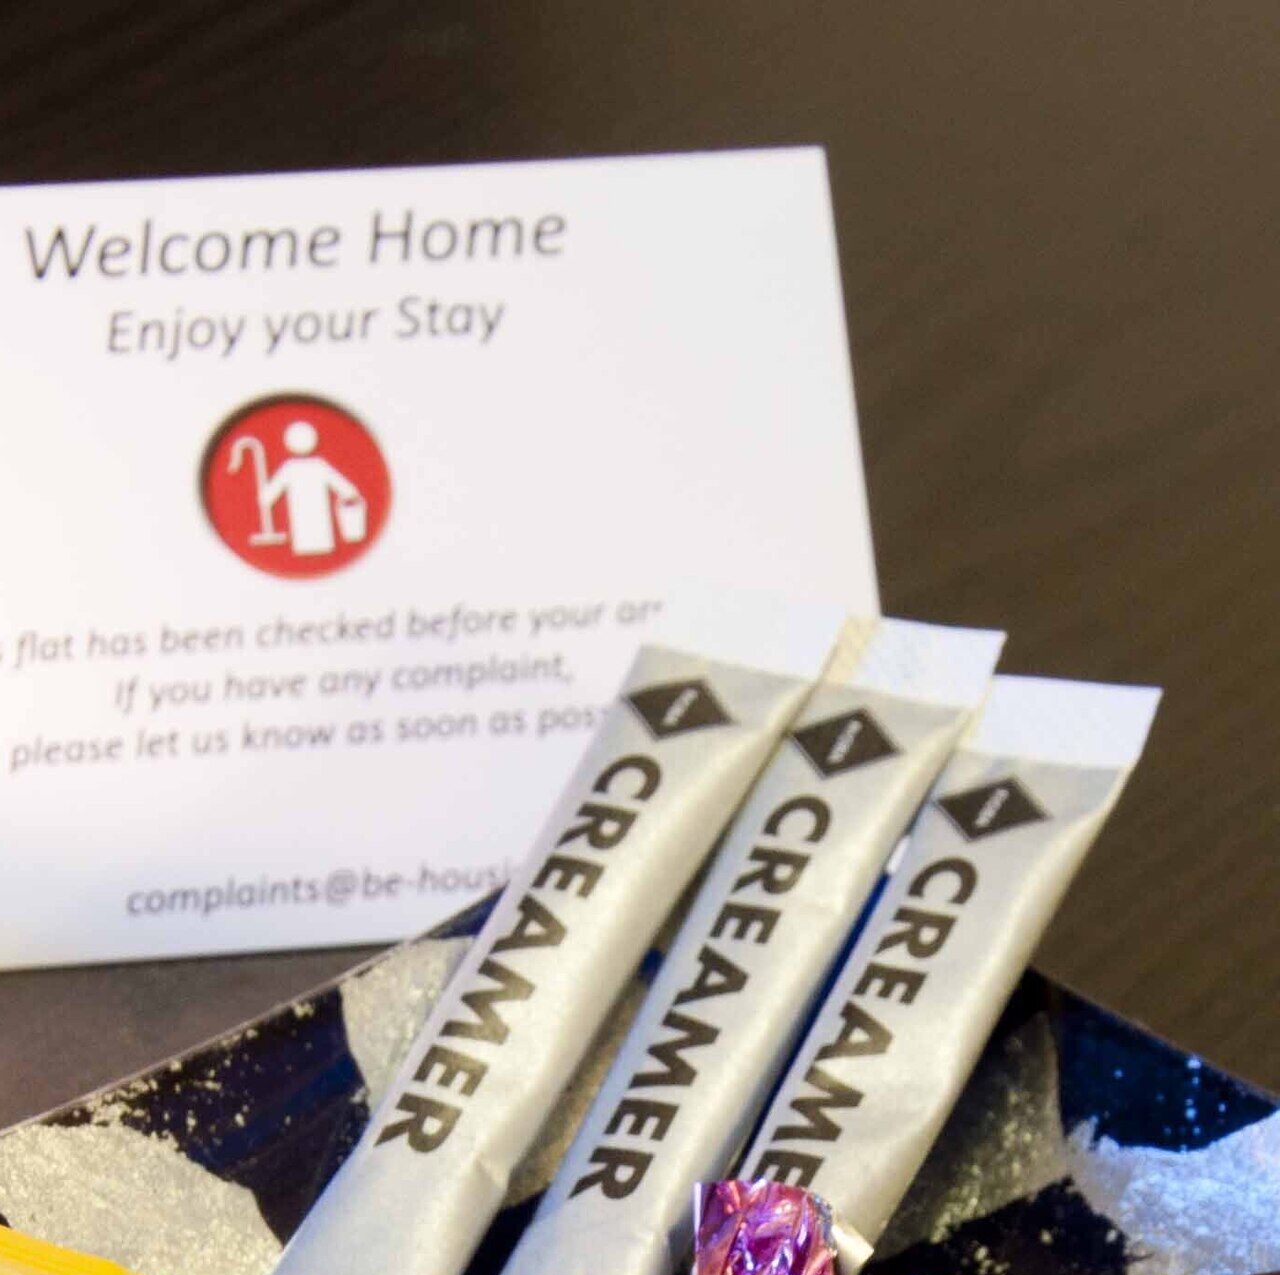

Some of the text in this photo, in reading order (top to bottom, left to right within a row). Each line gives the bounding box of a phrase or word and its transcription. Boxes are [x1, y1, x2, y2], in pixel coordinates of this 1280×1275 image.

[24, 207, 569, 280] Welcome Home
[106, 294, 507, 362] Enjoy your Stay
[13, 628, 76, 669] flat
[86, 628, 147, 658] has
[158, 622, 246, 656] been
[255, 607, 396, 650] checked
[405, 602, 519, 640] before
[529, 602, 604, 637] your
[616, 599, 664, 624] ar
[114, 652, 576, 716] If you have any complaint,
[8, 704, 604, 774] please let us know as soon as pos
[124, 857, 514, 916] complaints@be-housi
[373, 751, 664, 1155] CREAMER
[569, 794, 830, 1200] CREAMER
[742, 855, 979, 1189] CREAME
